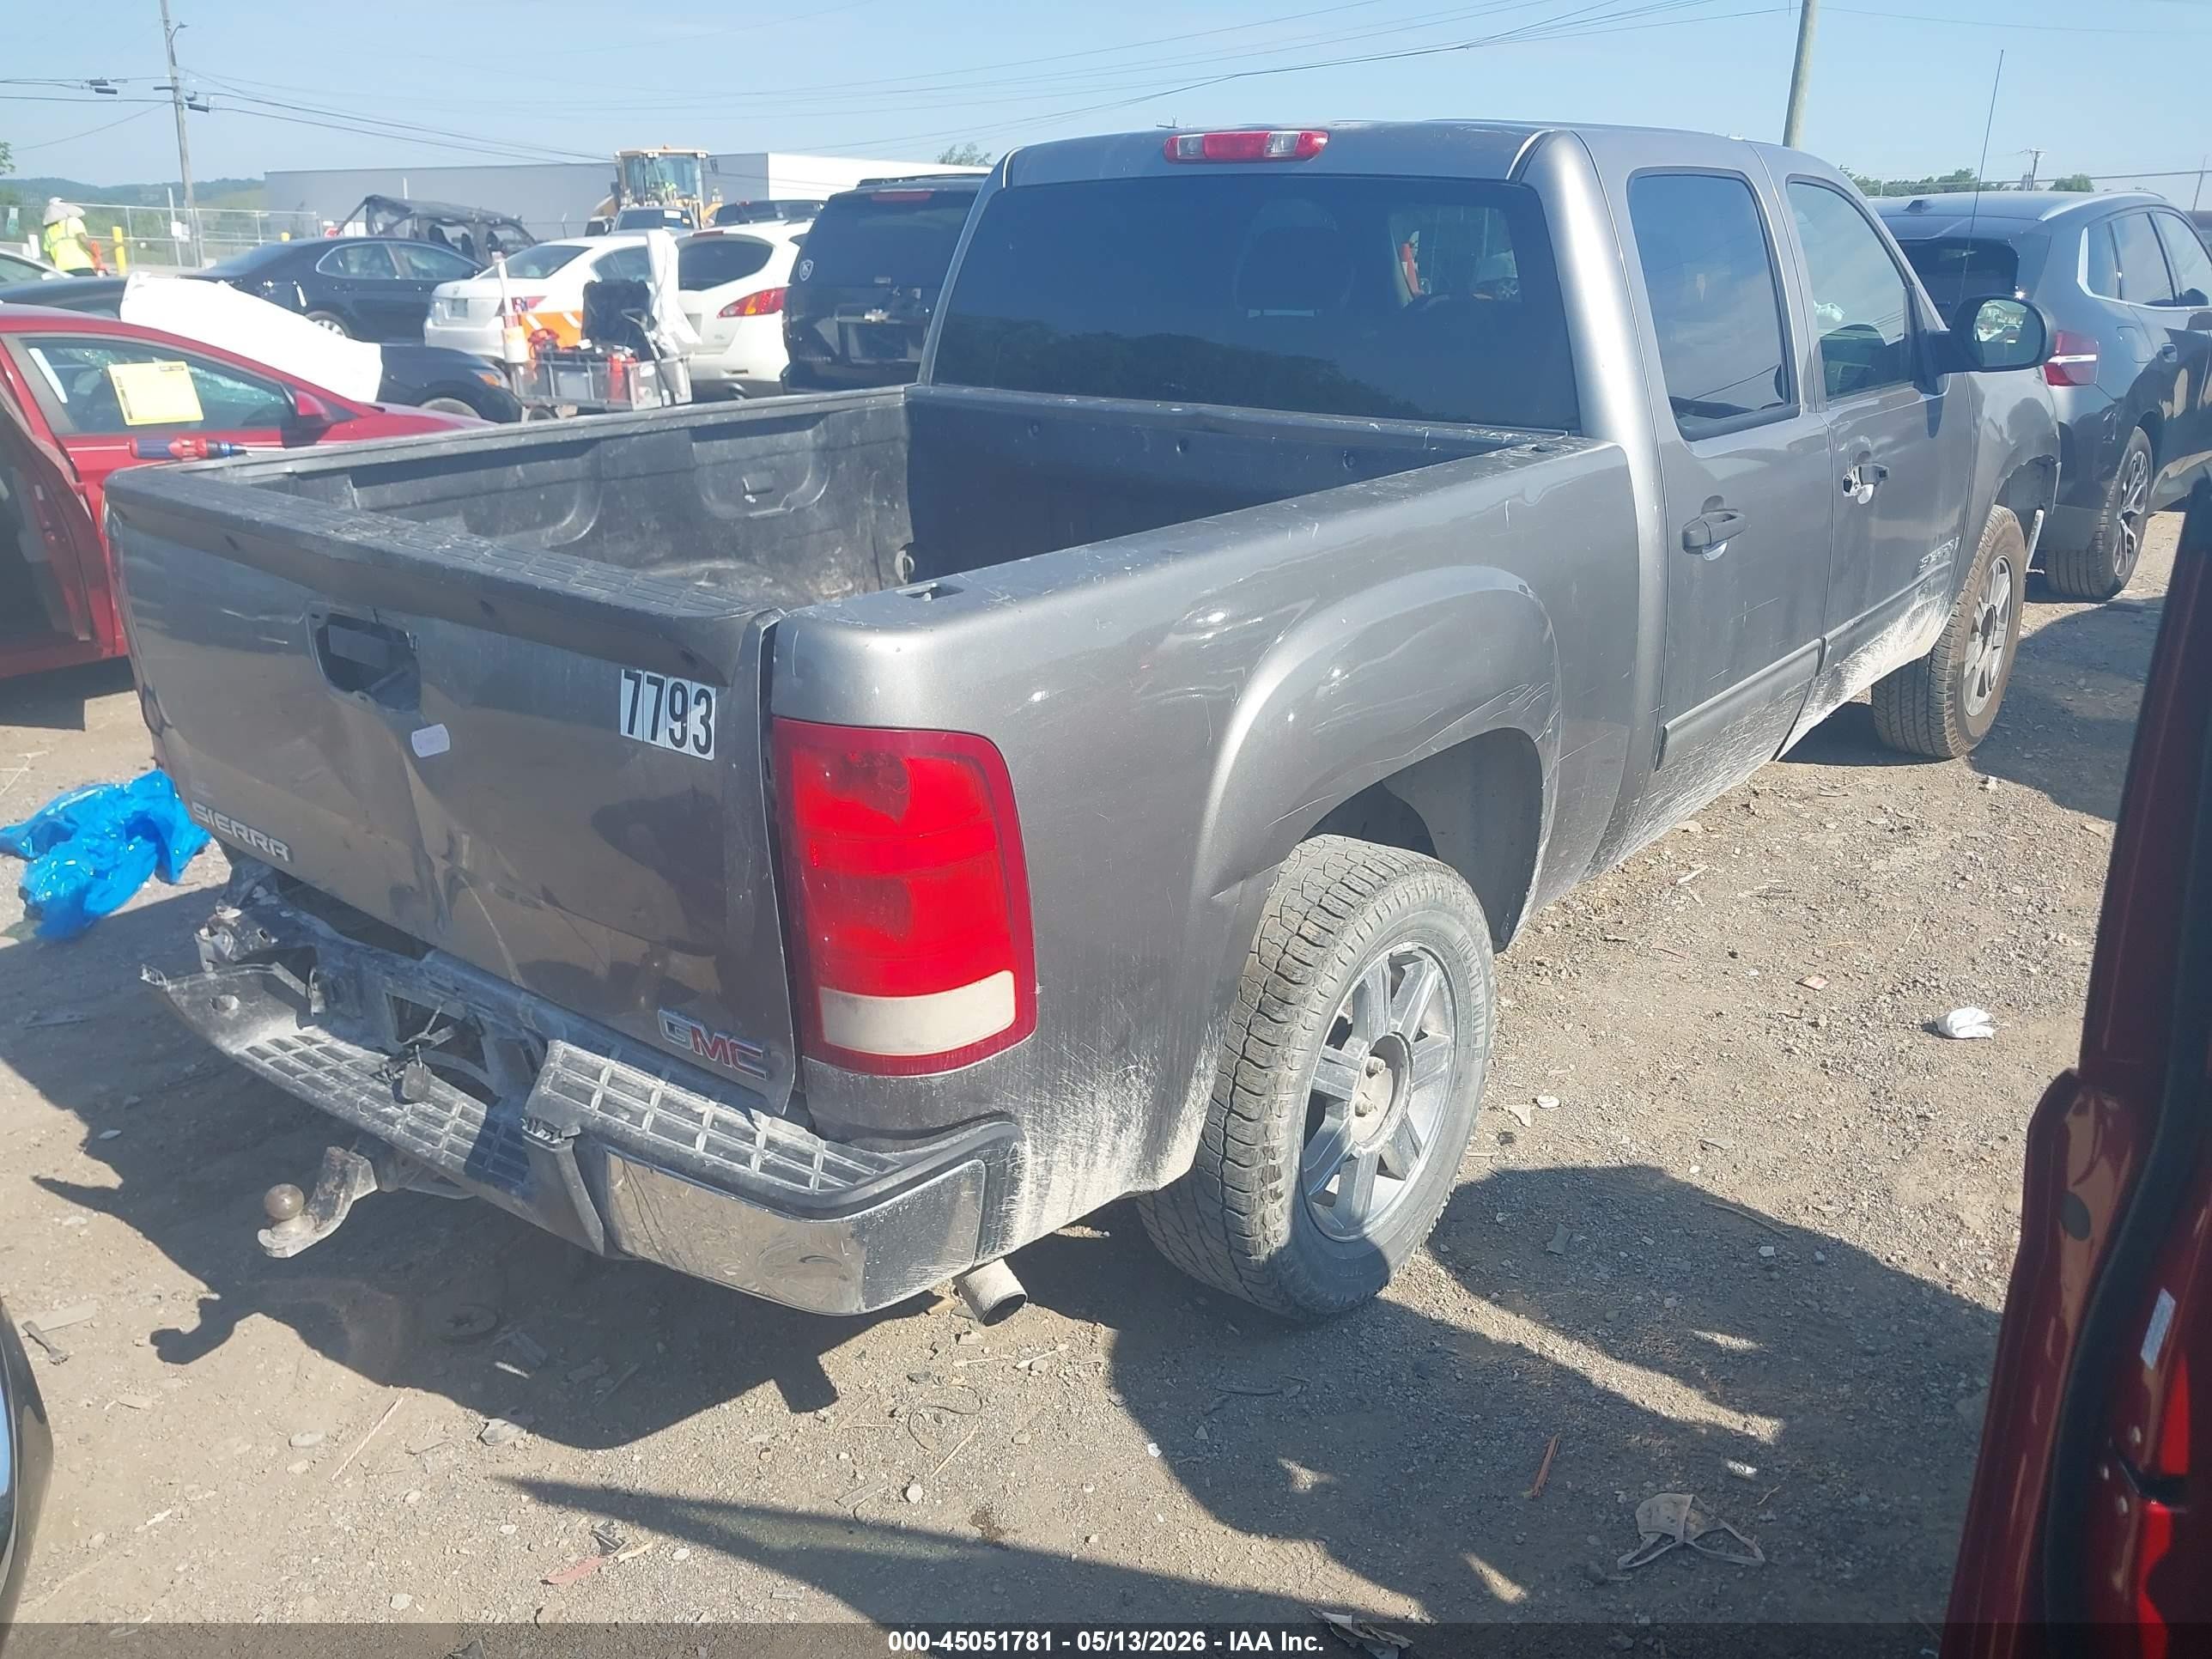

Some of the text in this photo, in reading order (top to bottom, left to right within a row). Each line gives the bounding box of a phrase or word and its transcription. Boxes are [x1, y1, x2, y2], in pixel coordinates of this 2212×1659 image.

[623, 670, 714, 756] 7793
[191, 800, 289, 861] SIERRA
[658, 1009, 768, 1081] GMC
